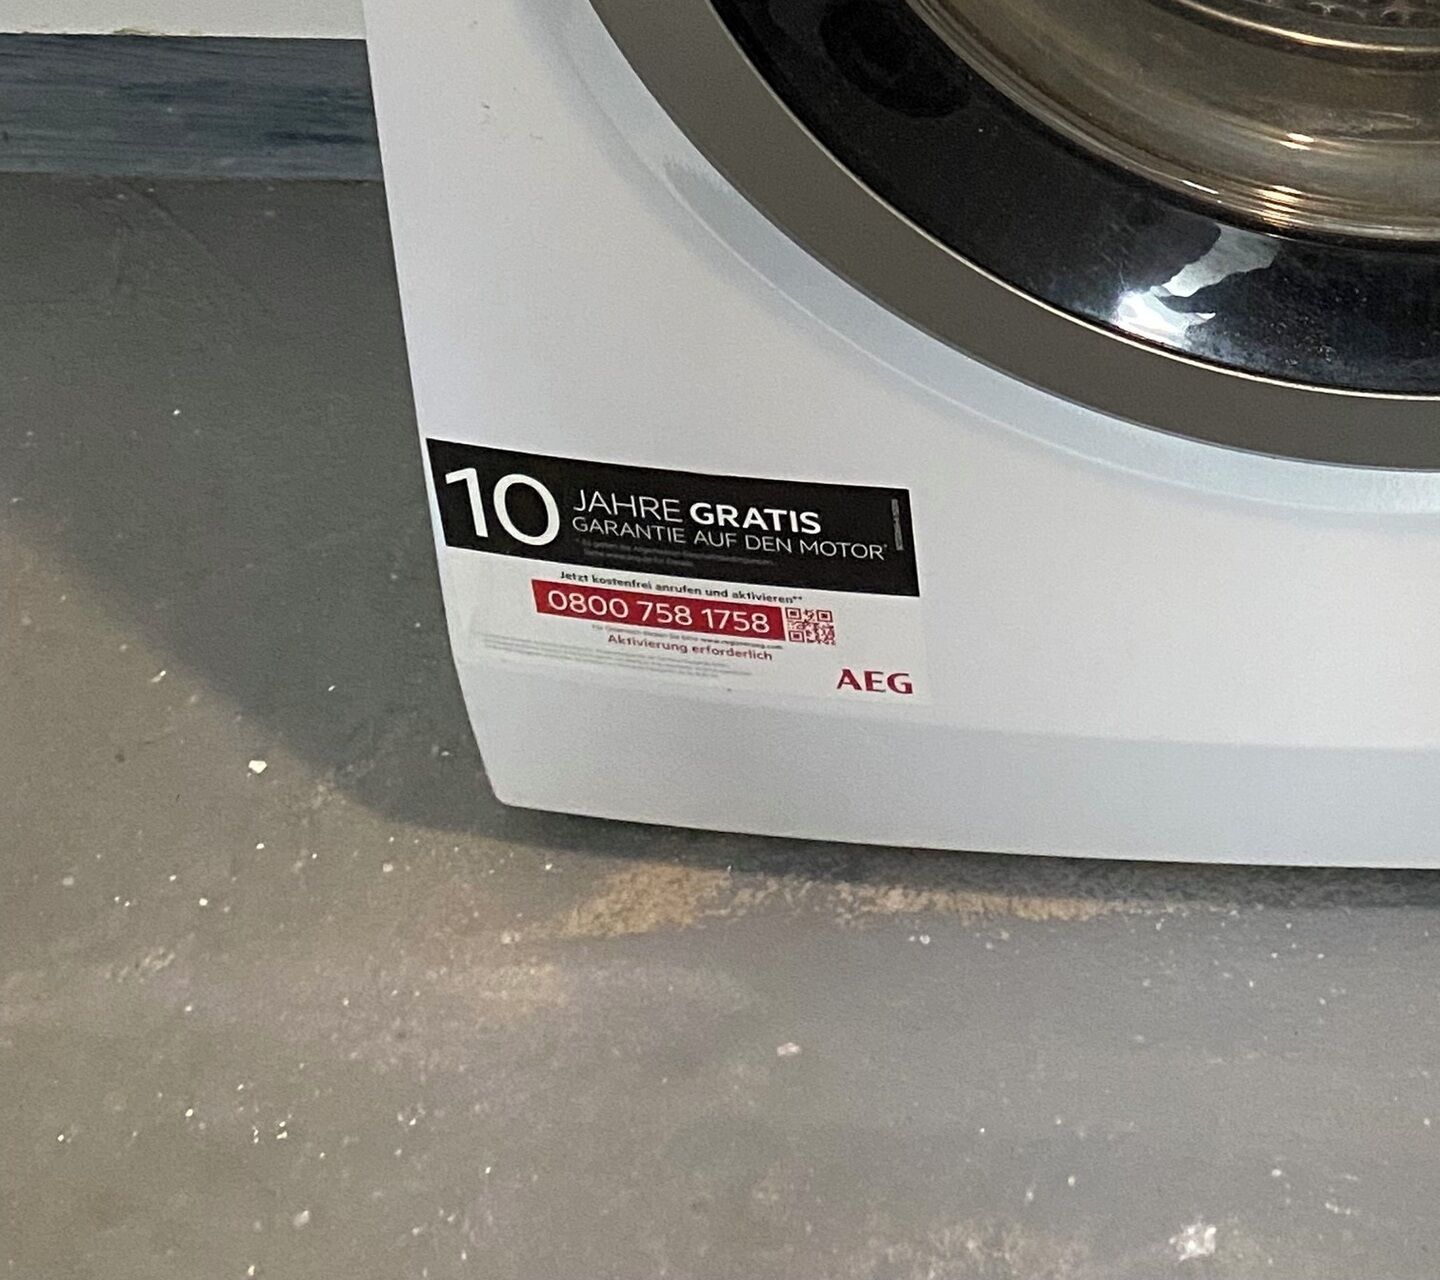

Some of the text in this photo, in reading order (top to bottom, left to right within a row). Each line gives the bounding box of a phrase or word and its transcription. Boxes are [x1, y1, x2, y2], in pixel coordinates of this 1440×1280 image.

[445, 467, 561, 547] 10
[572, 489, 823, 535] JAHRE GRATIS
[572, 516, 686, 545] GARANTIE
[694, 530, 737, 549] AUF
[745, 535, 793, 554] DEN
[561, 571, 589, 583] Jetzt
[655, 583, 702, 596] anrufen
[705, 588, 729, 599] und
[547, 590, 771, 634] 0800 758 1758
[607, 634, 688, 654] Aktivierung
[691, 646, 772, 661] erforderlich
[836, 668, 913, 695] AEG
